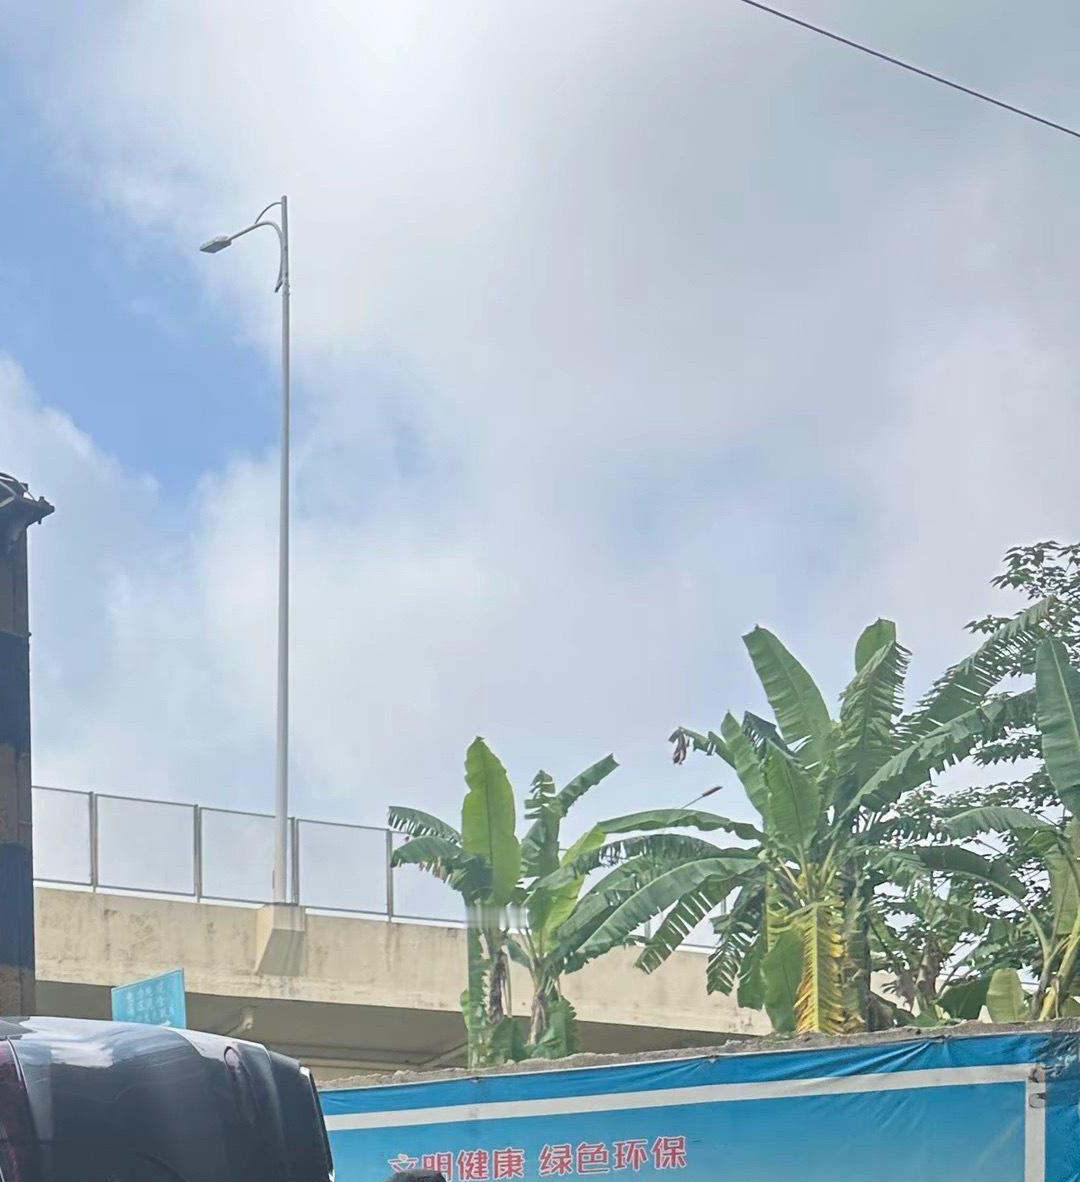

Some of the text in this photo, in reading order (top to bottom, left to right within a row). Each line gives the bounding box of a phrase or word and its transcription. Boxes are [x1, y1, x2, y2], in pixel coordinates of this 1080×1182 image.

[388, 1135, 687, 1182] 文明健康 绿色环保
